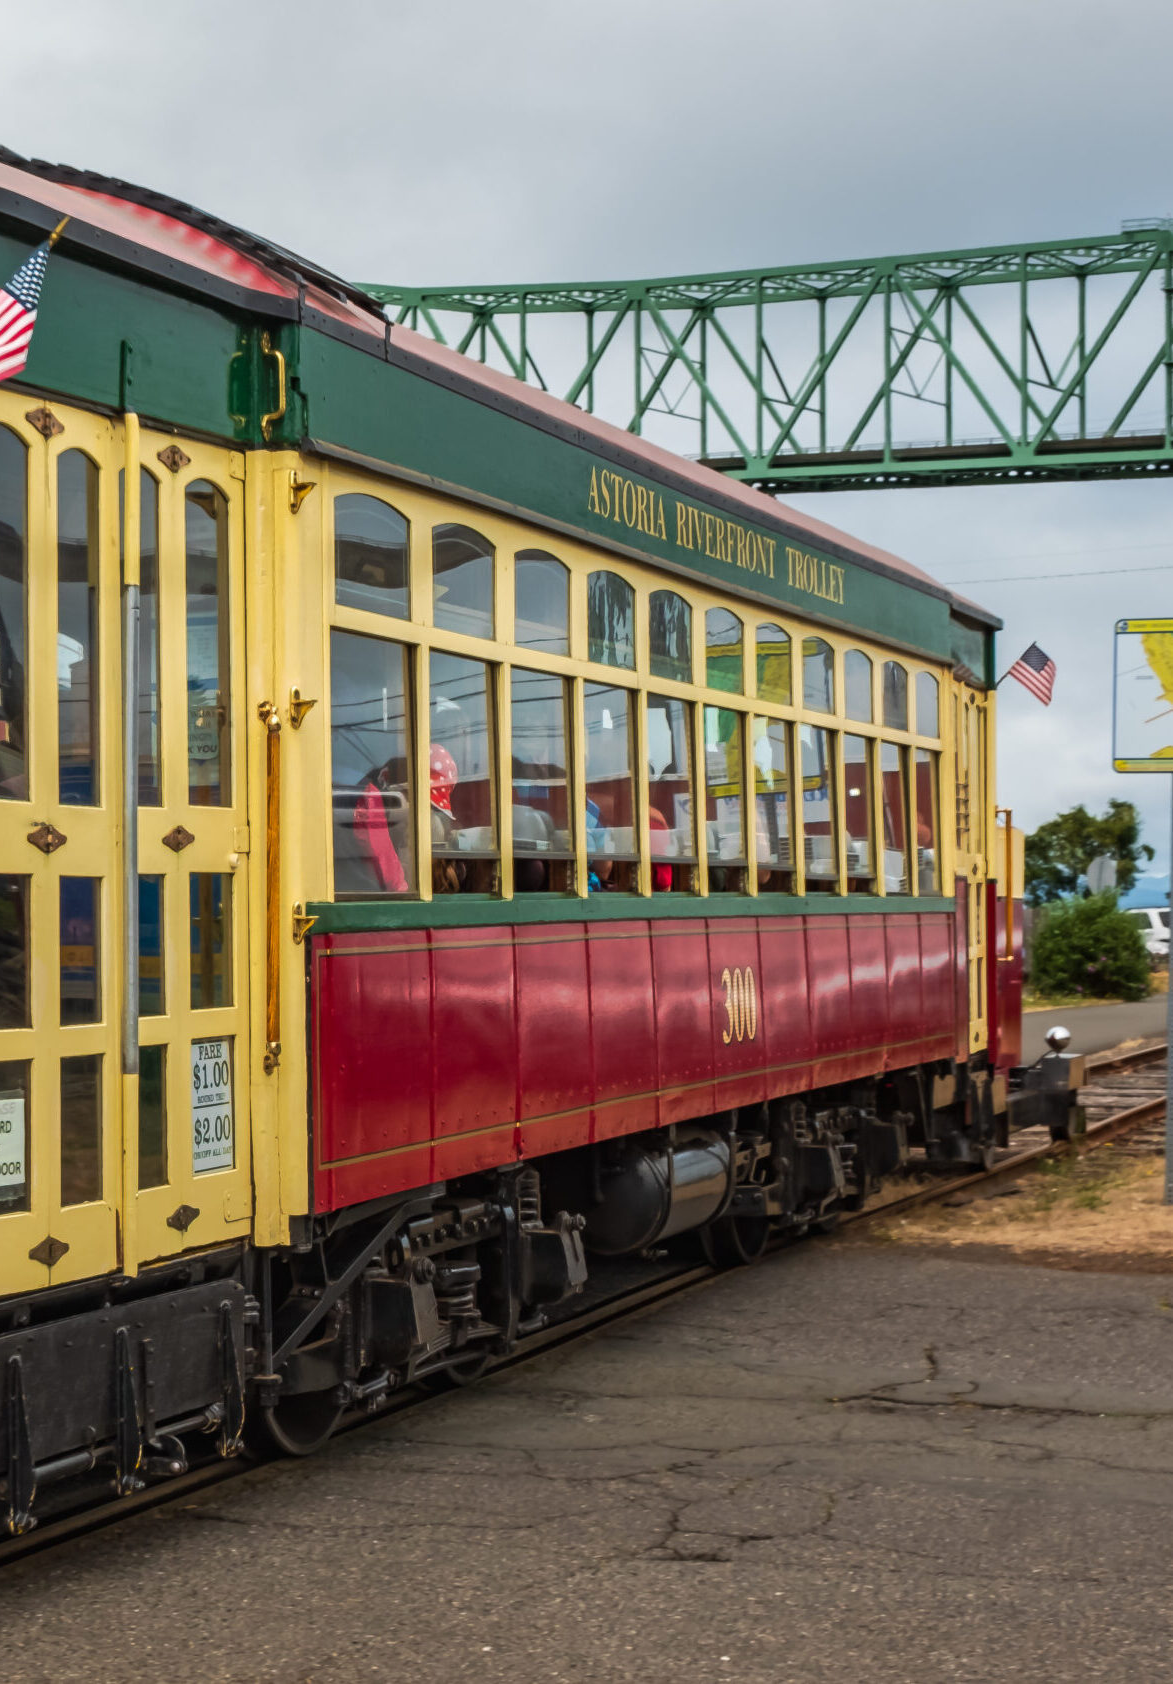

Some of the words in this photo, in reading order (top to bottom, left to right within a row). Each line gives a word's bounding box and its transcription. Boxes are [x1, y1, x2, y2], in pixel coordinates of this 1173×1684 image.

[587, 465, 668, 542] ASTORIA
[675, 500, 777, 580] RIVERFRONT
[785, 546, 845, 606] TROLLEY
[721, 966, 757, 1045] 300
[198, 1043, 222, 1061] FARE
[193, 1060, 229, 1094] $1.00
[194, 1114, 231, 1148] $2.00
